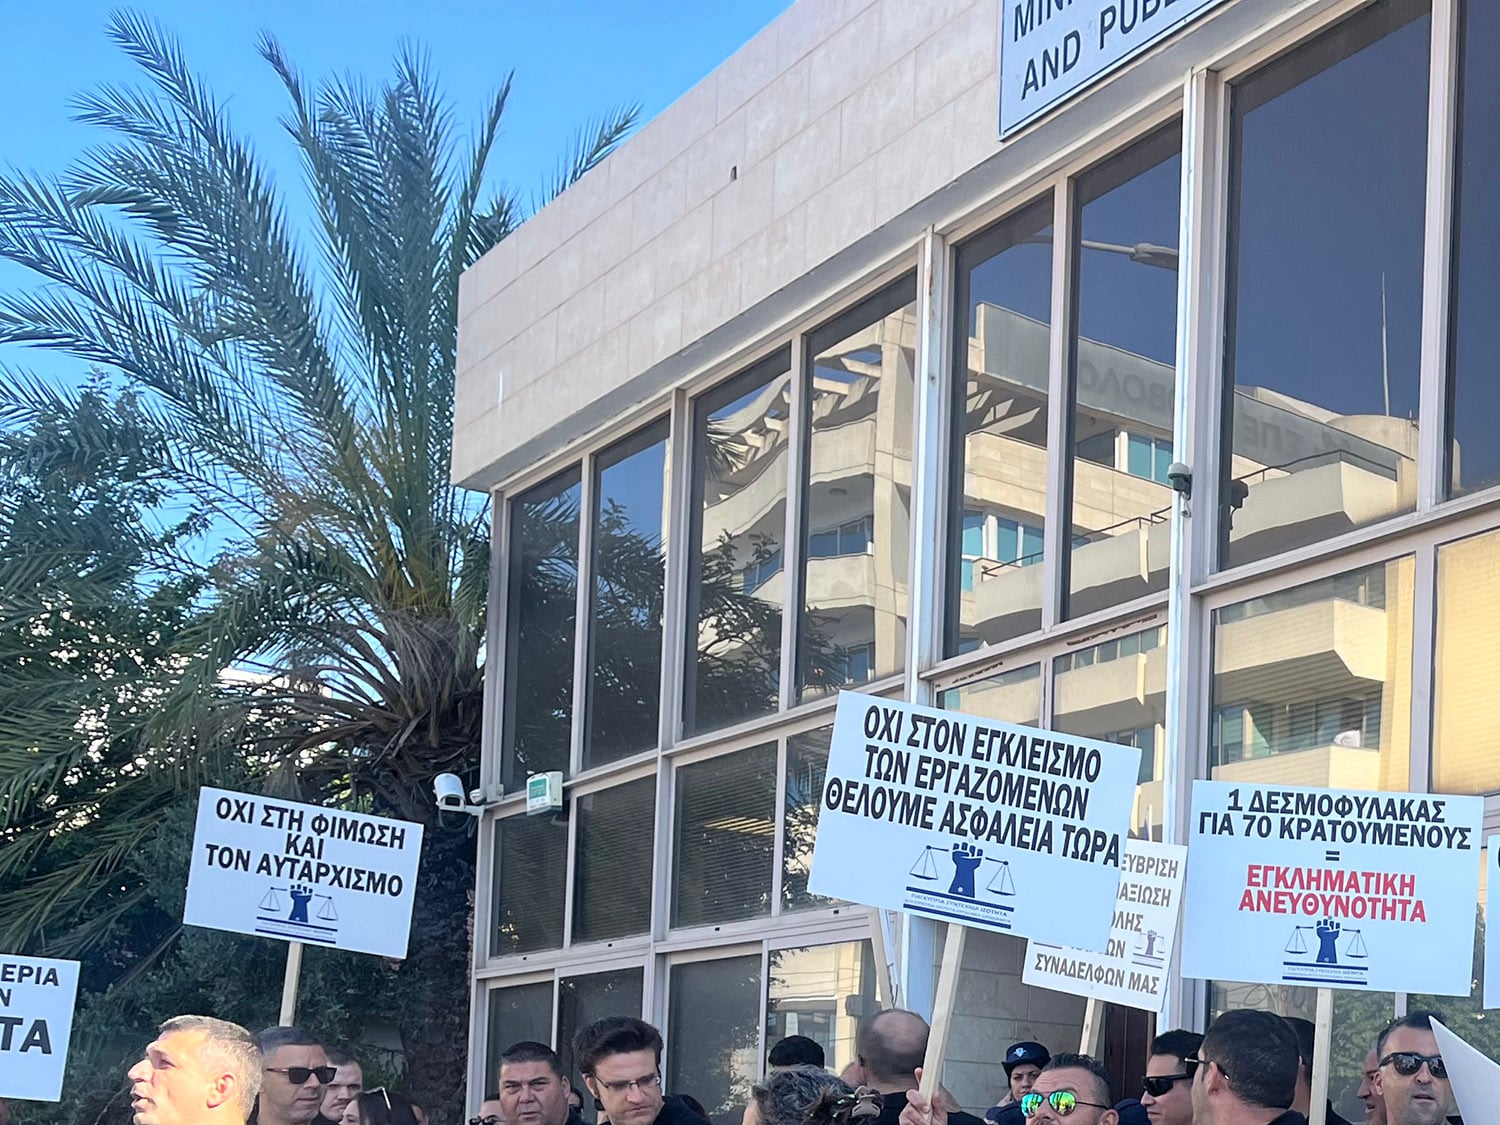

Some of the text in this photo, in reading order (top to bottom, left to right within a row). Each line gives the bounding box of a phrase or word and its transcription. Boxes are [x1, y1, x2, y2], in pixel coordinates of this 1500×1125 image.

[1014, 0, 1073, 42] MIN
[1021, 0, 1178, 100] AND PUB
[864, 705, 1101, 783] ΟΧΙ ΣΤΟΝ ΕΓΚΛΕΙΣΜΟ
[865, 744, 1090, 821] ΤΩΝ ΕΡΓΑΖΟΜΕΝΩΝ
[216, 797, 406, 850] ΟΧΙ ΣΤΗ ΦΙΜΩΣΗ
[825, 777, 1120, 868] ΘΕΛΟΥΜΕ ΑΣΦΑΛΕΙΑ ΤΩΡΑ
[1227, 788, 1446, 823] 1 ΔΕΣΜΟΦΥΛΑΚΑΣ
[285, 833, 324, 860] ΚΑΙ
[1199, 812, 1472, 850] ΓΙΑ 70 ΚΡΑΤΟΥΜΕΝΟΥΣ
[205, 844, 403, 897] ΤΟΝ ΑΥΤΑΡΧΙΣΜΟ
[1247, 864, 1416, 897] ΕΓΚΛΗΜΑΤΙΚΗ
[1116, 881, 1171, 907] ΑΞΙΩΣΗ
[1238, 889, 1427, 923] ΑΝΕΥΘΥΝΟΤΗΤΑ
[1, 963, 59, 987] ΕΡΙΑ
[1035, 953, 1160, 995] ΣΥΝΑΔΕΛΦΩΝ ΜΑΣ
